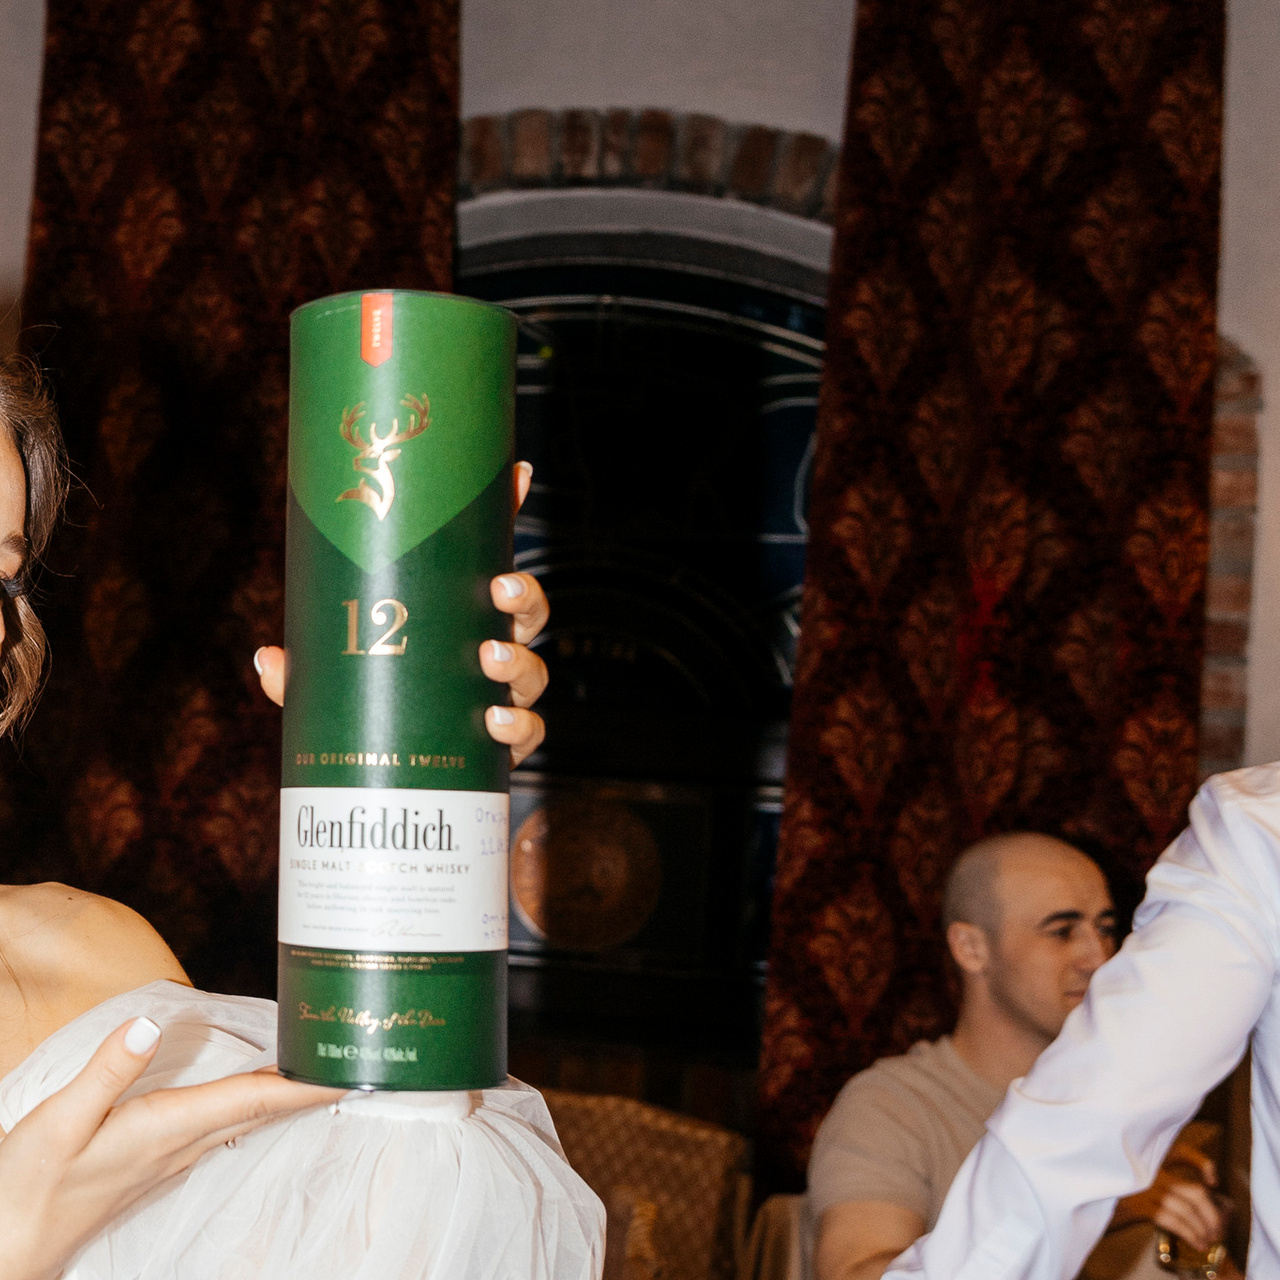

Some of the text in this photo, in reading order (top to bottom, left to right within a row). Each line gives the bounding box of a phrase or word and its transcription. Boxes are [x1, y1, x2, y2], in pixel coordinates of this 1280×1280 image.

[341, 598, 409, 656] 12
[320, 752, 401, 767] ORIGINAL
[409, 754, 467, 769] TWELVE
[297, 804, 454, 852] Glenfiddich
[289, 858, 318, 871] SINGLE
[321, 860, 352, 872] MALT
[423, 862, 471, 875] WHISKY
